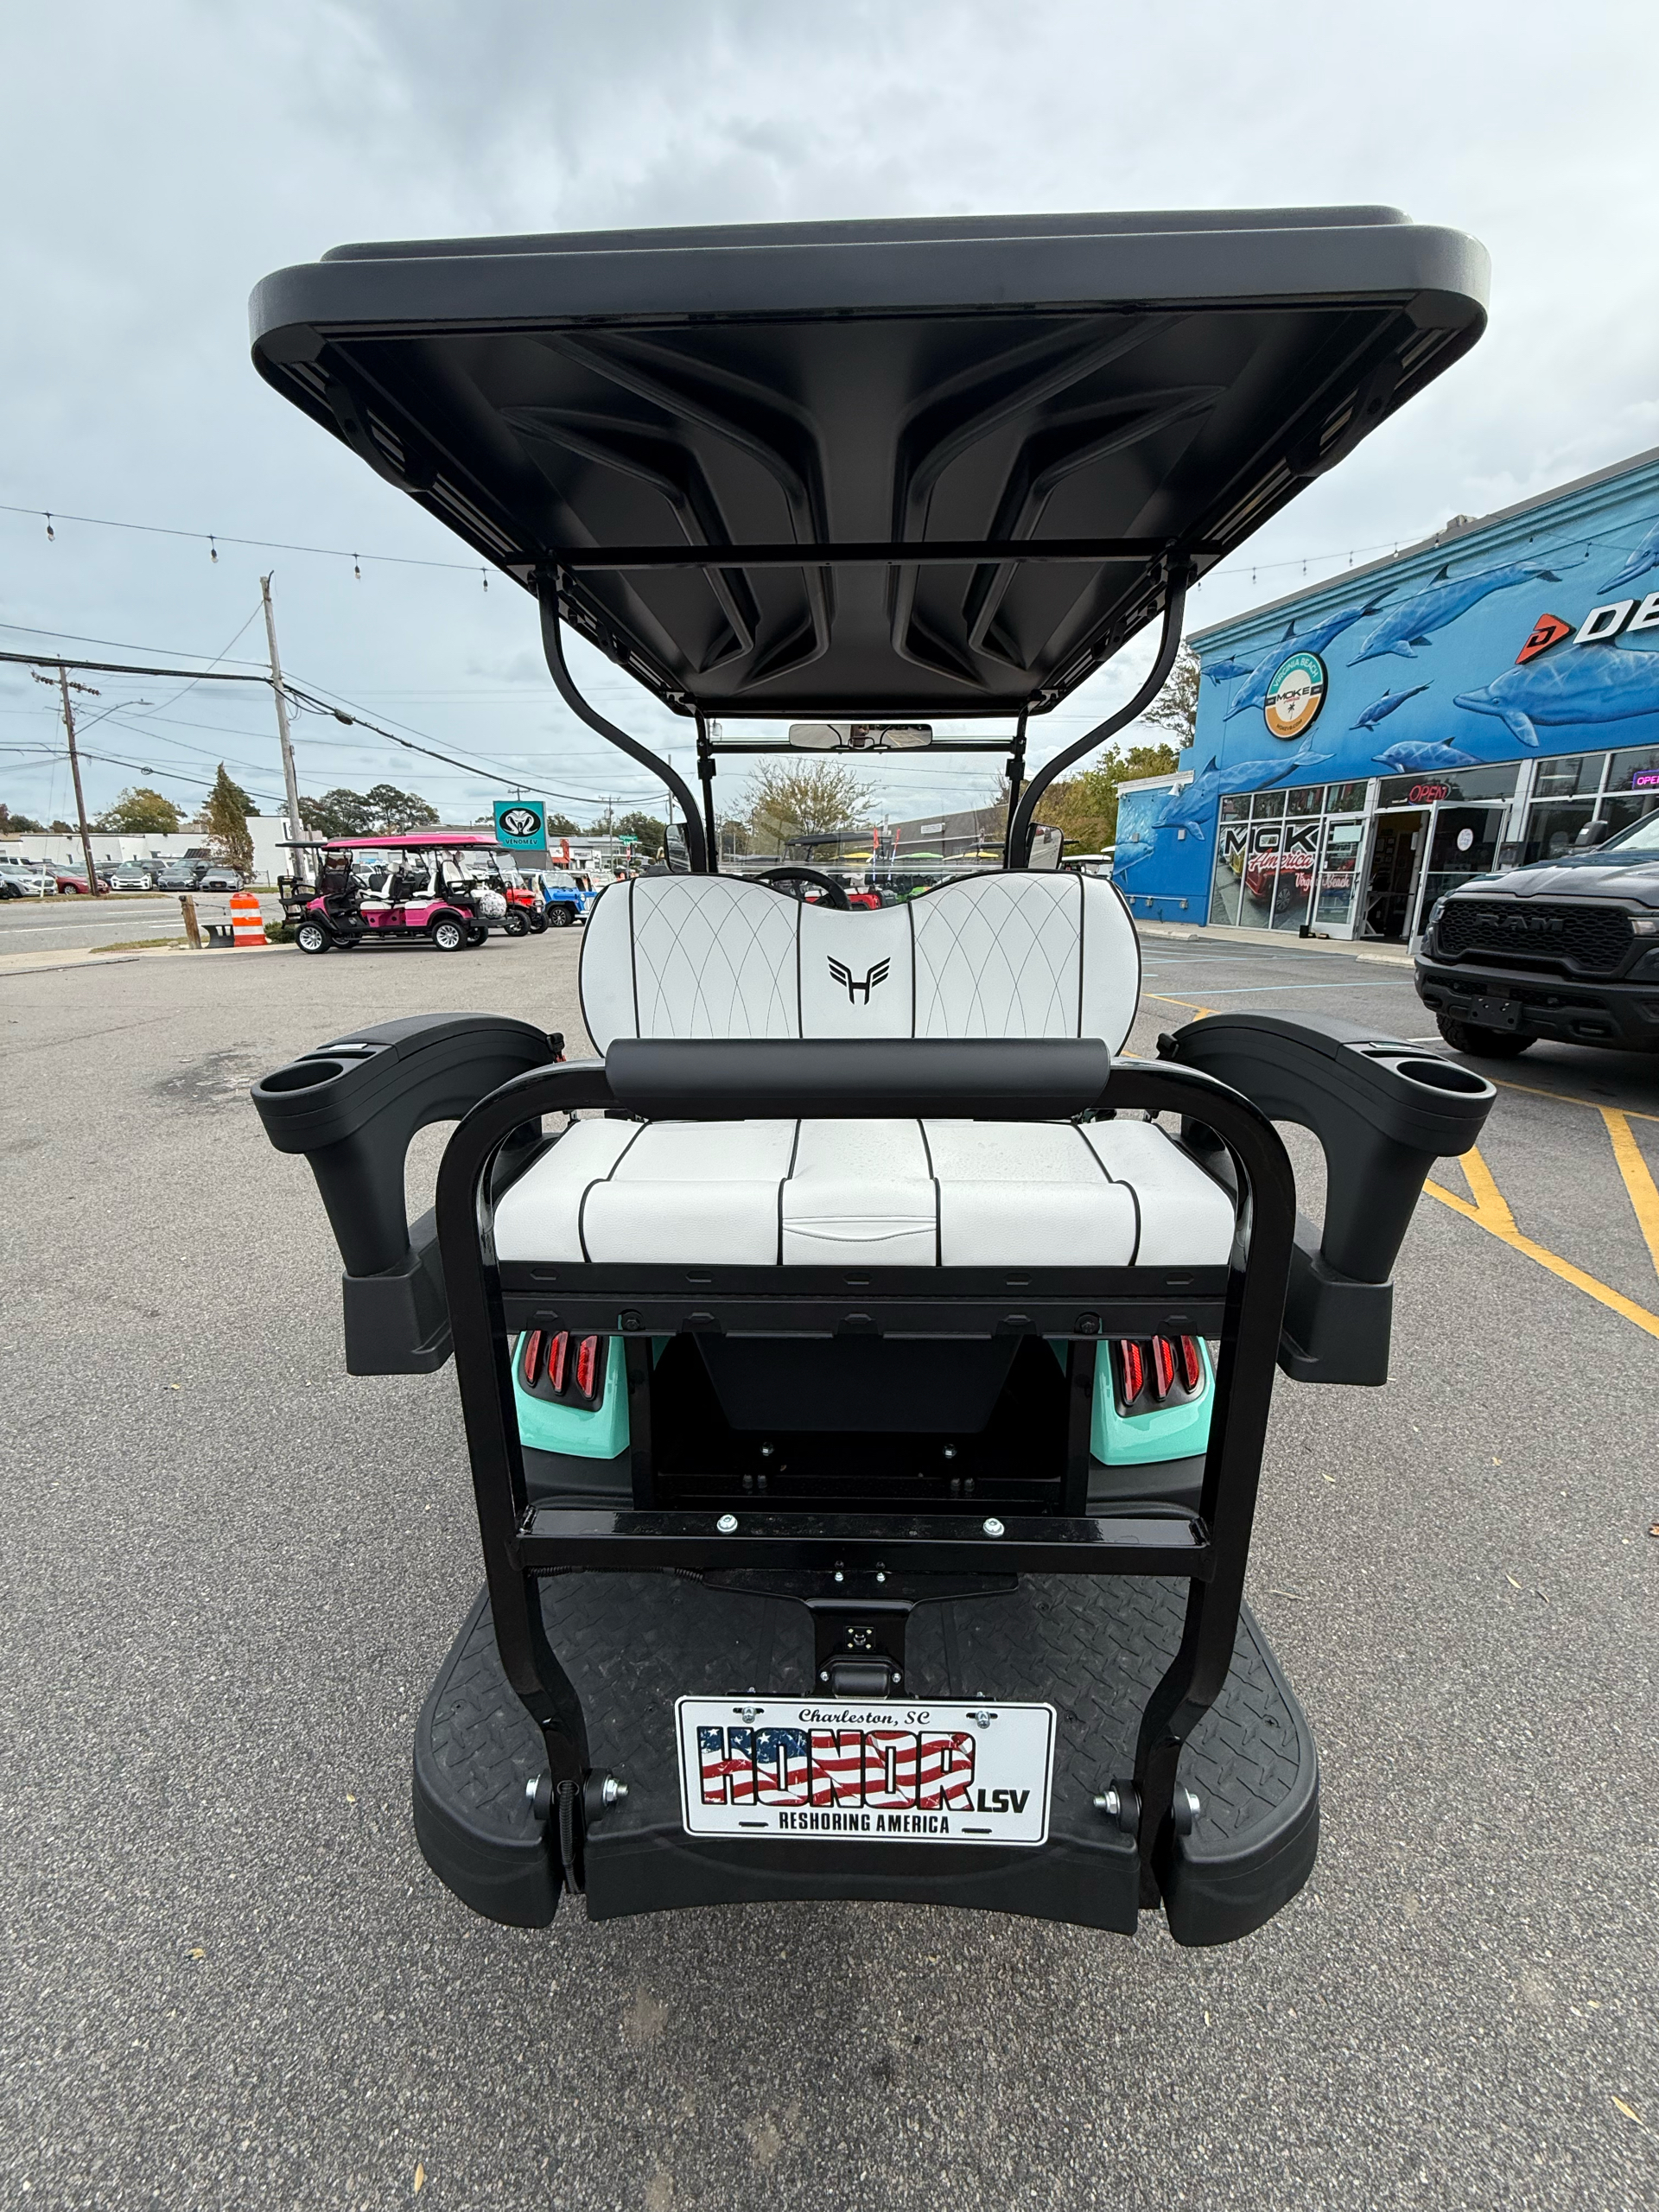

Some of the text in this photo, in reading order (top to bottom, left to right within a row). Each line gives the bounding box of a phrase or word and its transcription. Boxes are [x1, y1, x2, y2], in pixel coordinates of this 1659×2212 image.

[1273, 658, 1319, 687] VIRGINIA BEACH
[1276, 686, 1311, 702] MOKE
[1409, 785, 1447, 803] OPEN
[1249, 848, 1315, 872] America
[1476, 913, 1565, 931] RAM
[798, 1708, 931, 1726] Charleston, SC
[696, 1726, 1031, 1814] HONOR LSV
[779, 1811, 950, 1834] RESHORING AMERICA
